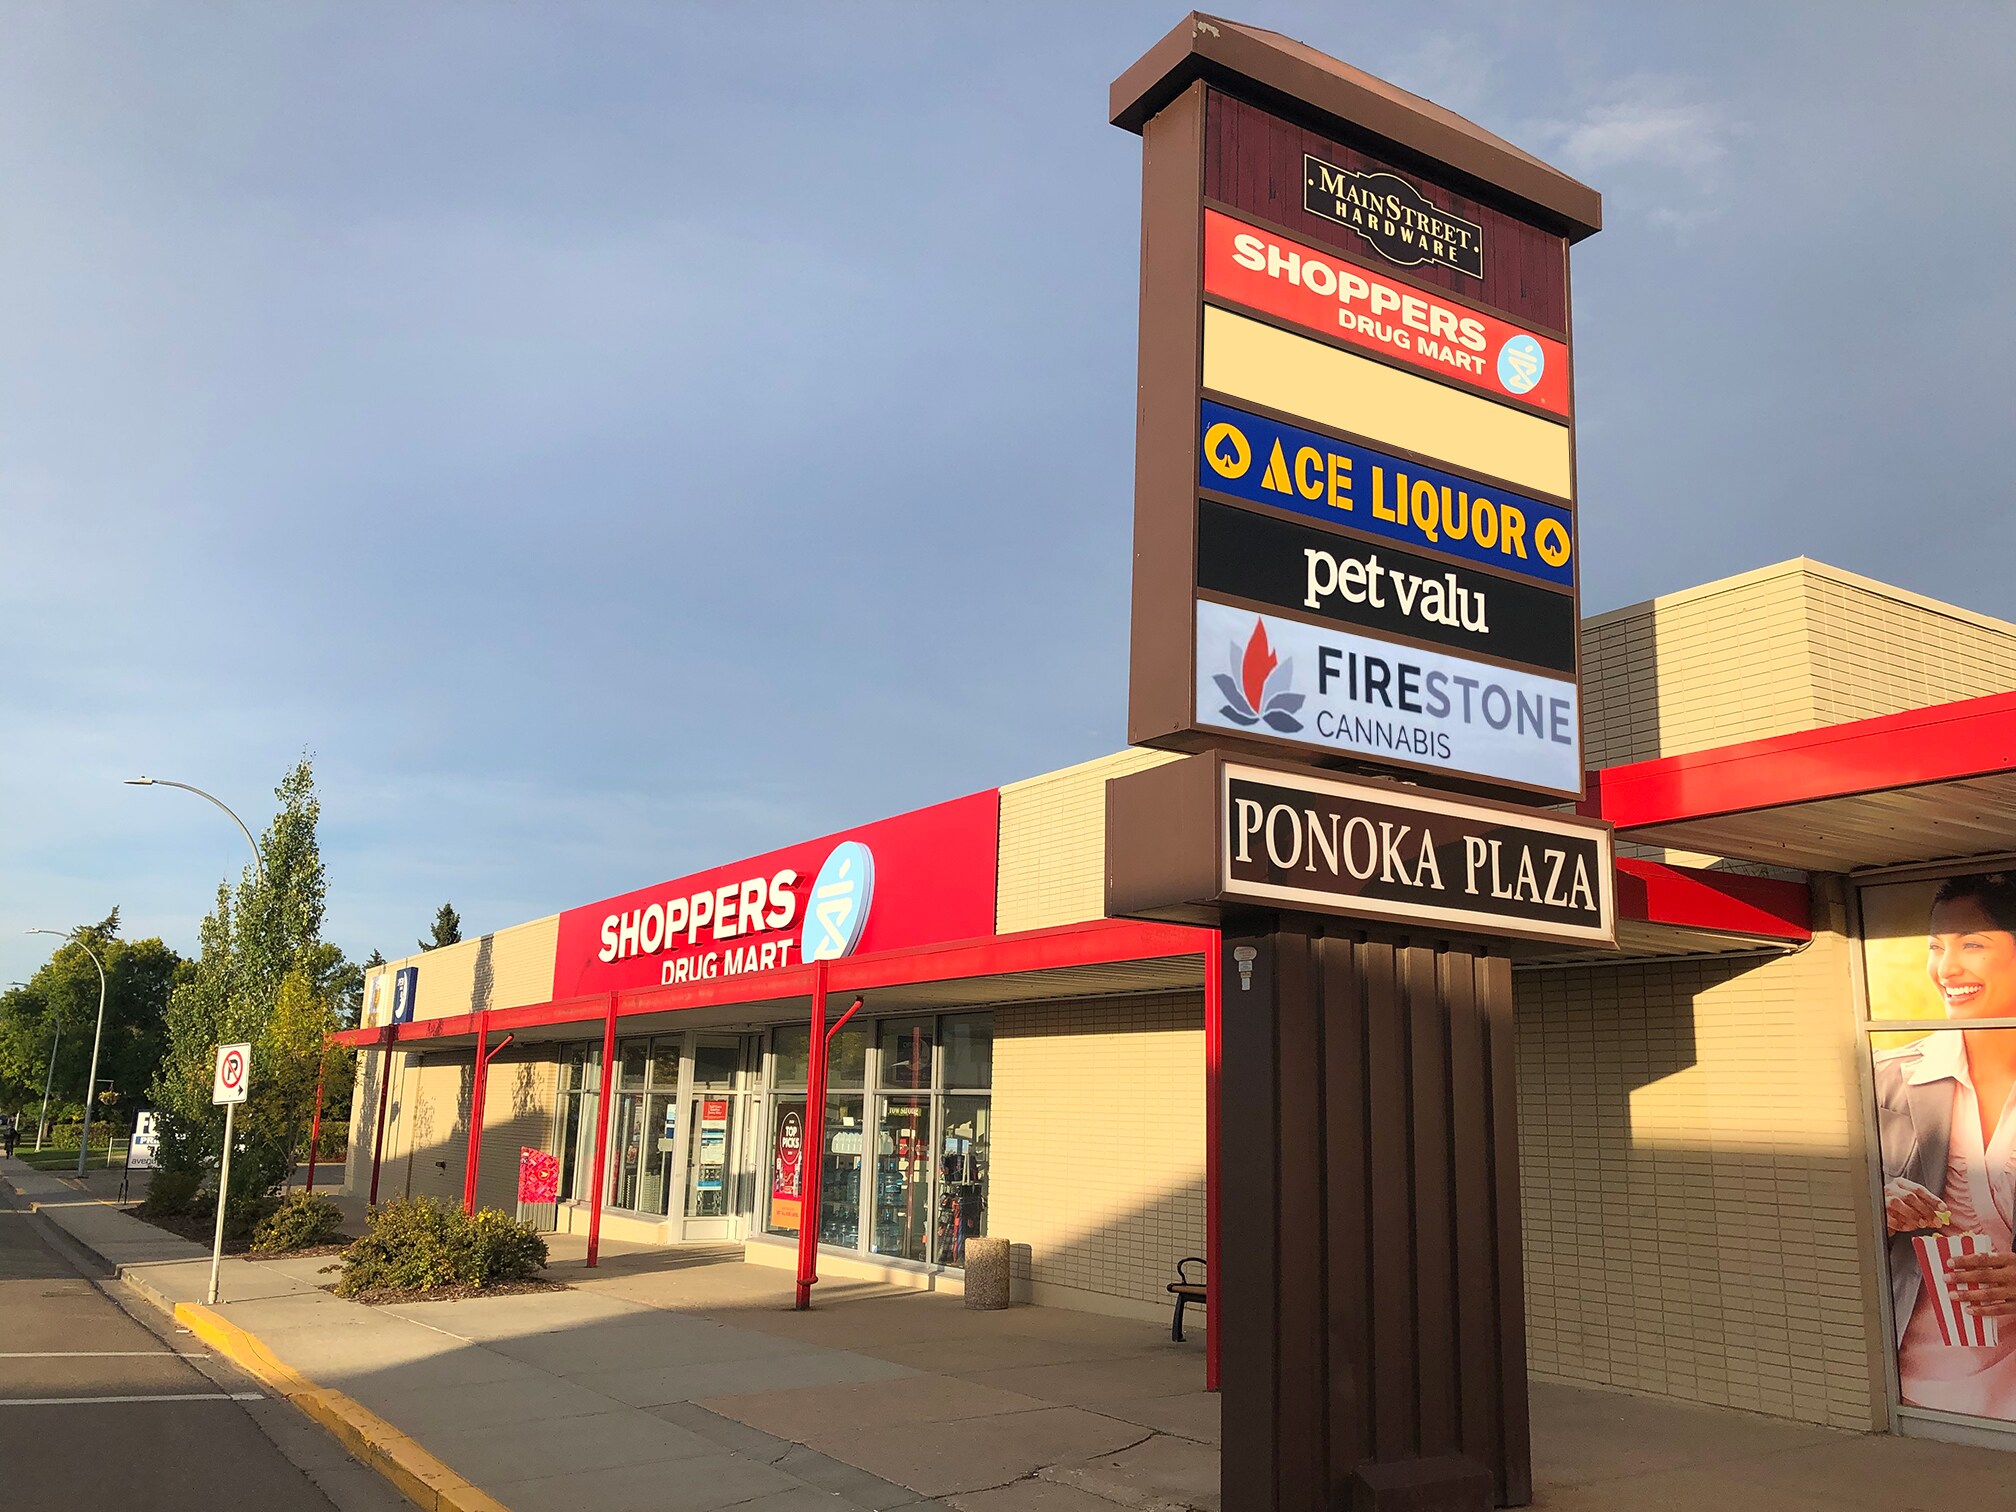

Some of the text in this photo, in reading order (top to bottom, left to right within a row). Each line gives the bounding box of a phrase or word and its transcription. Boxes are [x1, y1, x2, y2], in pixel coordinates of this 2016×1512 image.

[1336, 200, 1458, 263] HARDWARE
[1232, 234, 1487, 352] SHOPPERS
[1339, 308, 1487, 376] DRUG MART
[1261, 436, 1528, 559] ACE LIQUOR
[1303, 547, 1489, 634] pet valu
[1318, 646, 1573, 746] FIRESTONE
[1317, 710, 1452, 760] CANNABIS
[1235, 798, 1597, 912] PONOKA PLAZA
[598, 869, 798, 963] SHOPPERS
[661, 939, 794, 985] DRUG MART
[782, 1137, 799, 1148] PICKS
[785, 1126, 797, 1137] TOP
